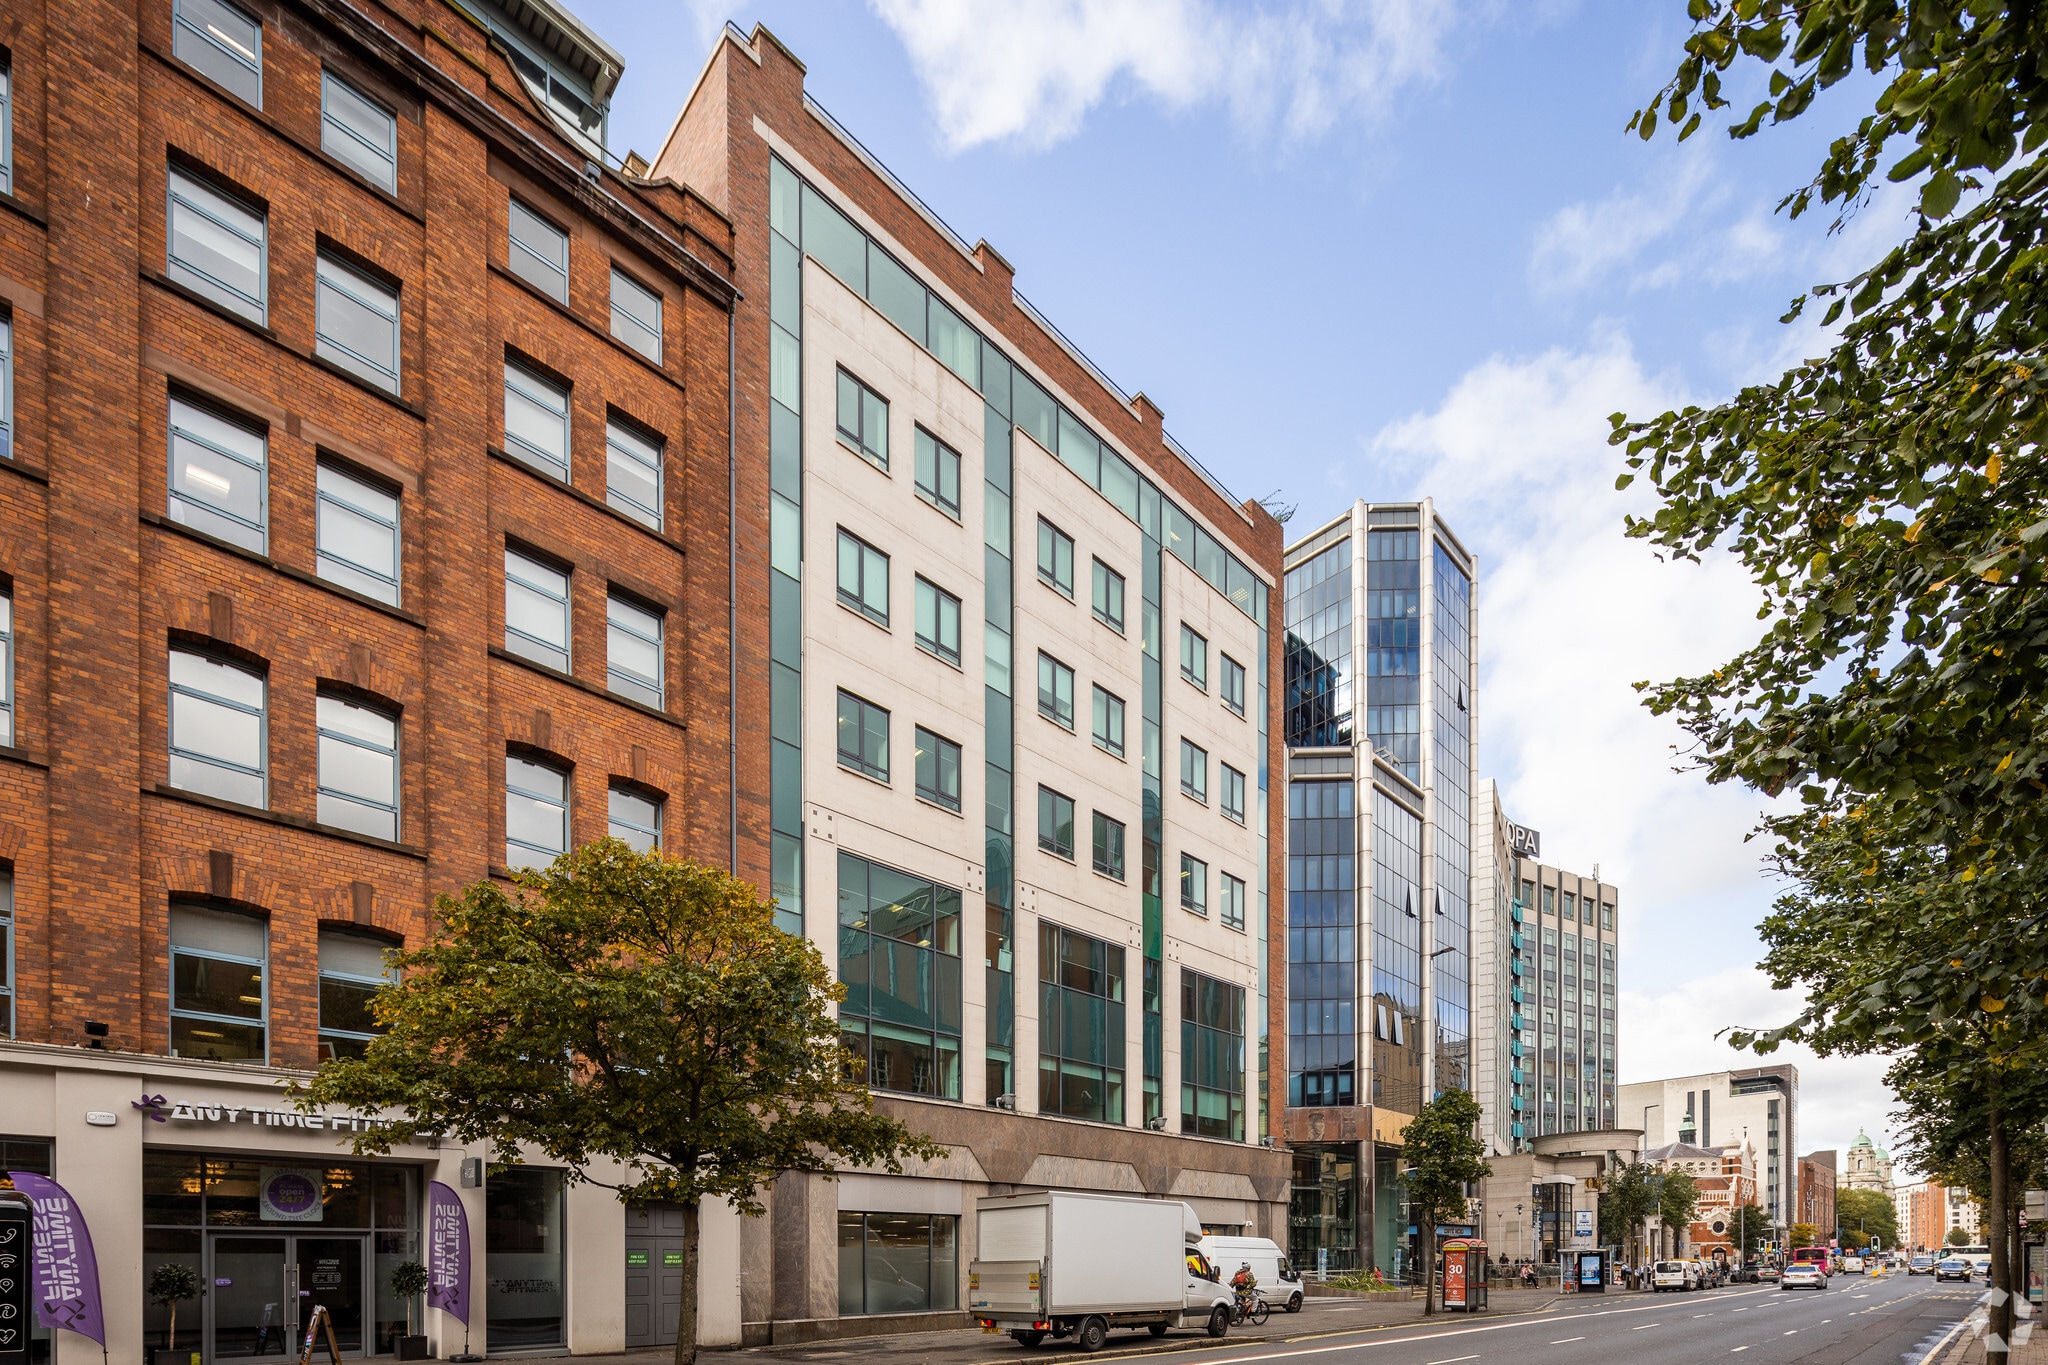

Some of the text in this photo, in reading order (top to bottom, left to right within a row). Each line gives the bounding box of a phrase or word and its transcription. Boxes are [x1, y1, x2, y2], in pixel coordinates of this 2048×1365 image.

[1506, 821, 1537, 853] OPA
[170, 1100, 323, 1129] ANYTIME
[279, 1189, 305, 1197] open
[279, 1196, 305, 1204] 24/7
[260, 1200, 287, 1220] AROUND
[303, 1201, 322, 1219] CLOCK
[1449, 1265, 1463, 1274] 30
[506, 1279, 555, 1287] ANYTIME
[506, 1286, 557, 1294] FITNESS
